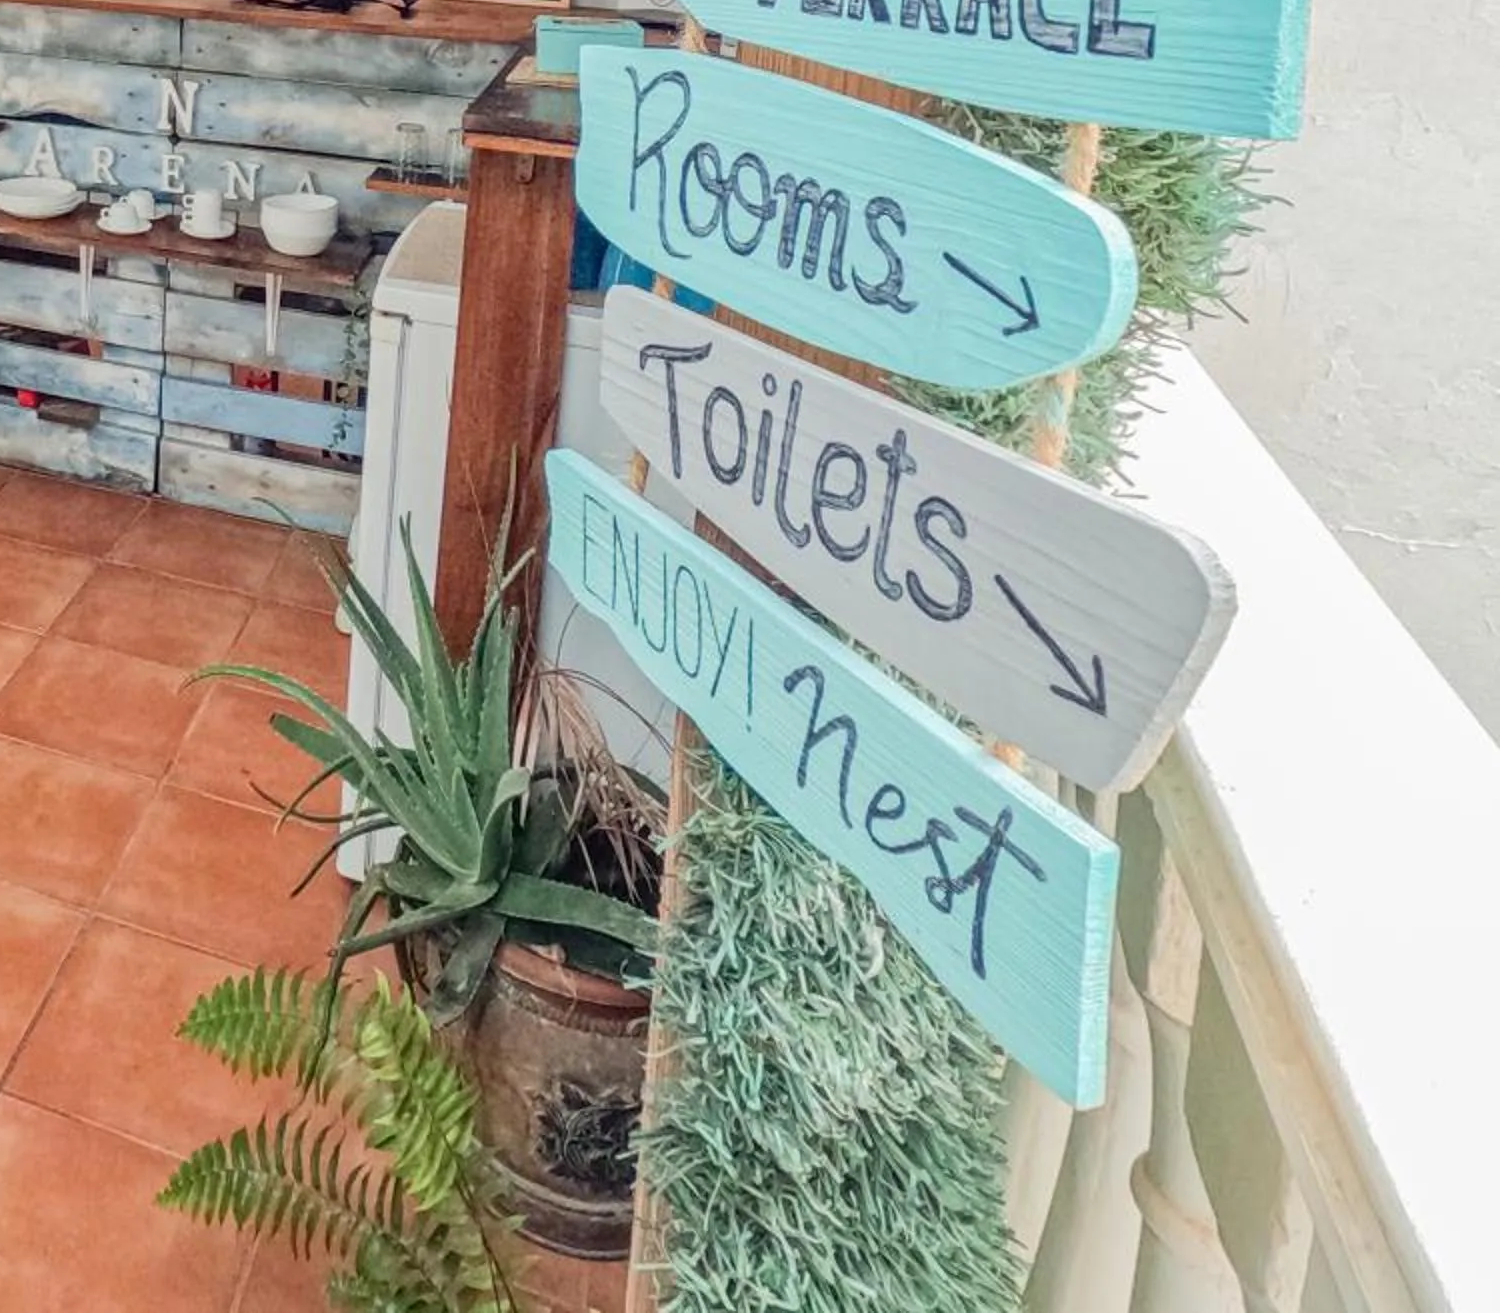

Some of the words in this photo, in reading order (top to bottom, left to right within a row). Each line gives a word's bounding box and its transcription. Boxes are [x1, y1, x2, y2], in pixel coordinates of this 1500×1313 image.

[626, 66, 919, 315] Rooms
[640, 342, 973, 622] Toilets
[582, 494, 756, 733] ENJOY!
